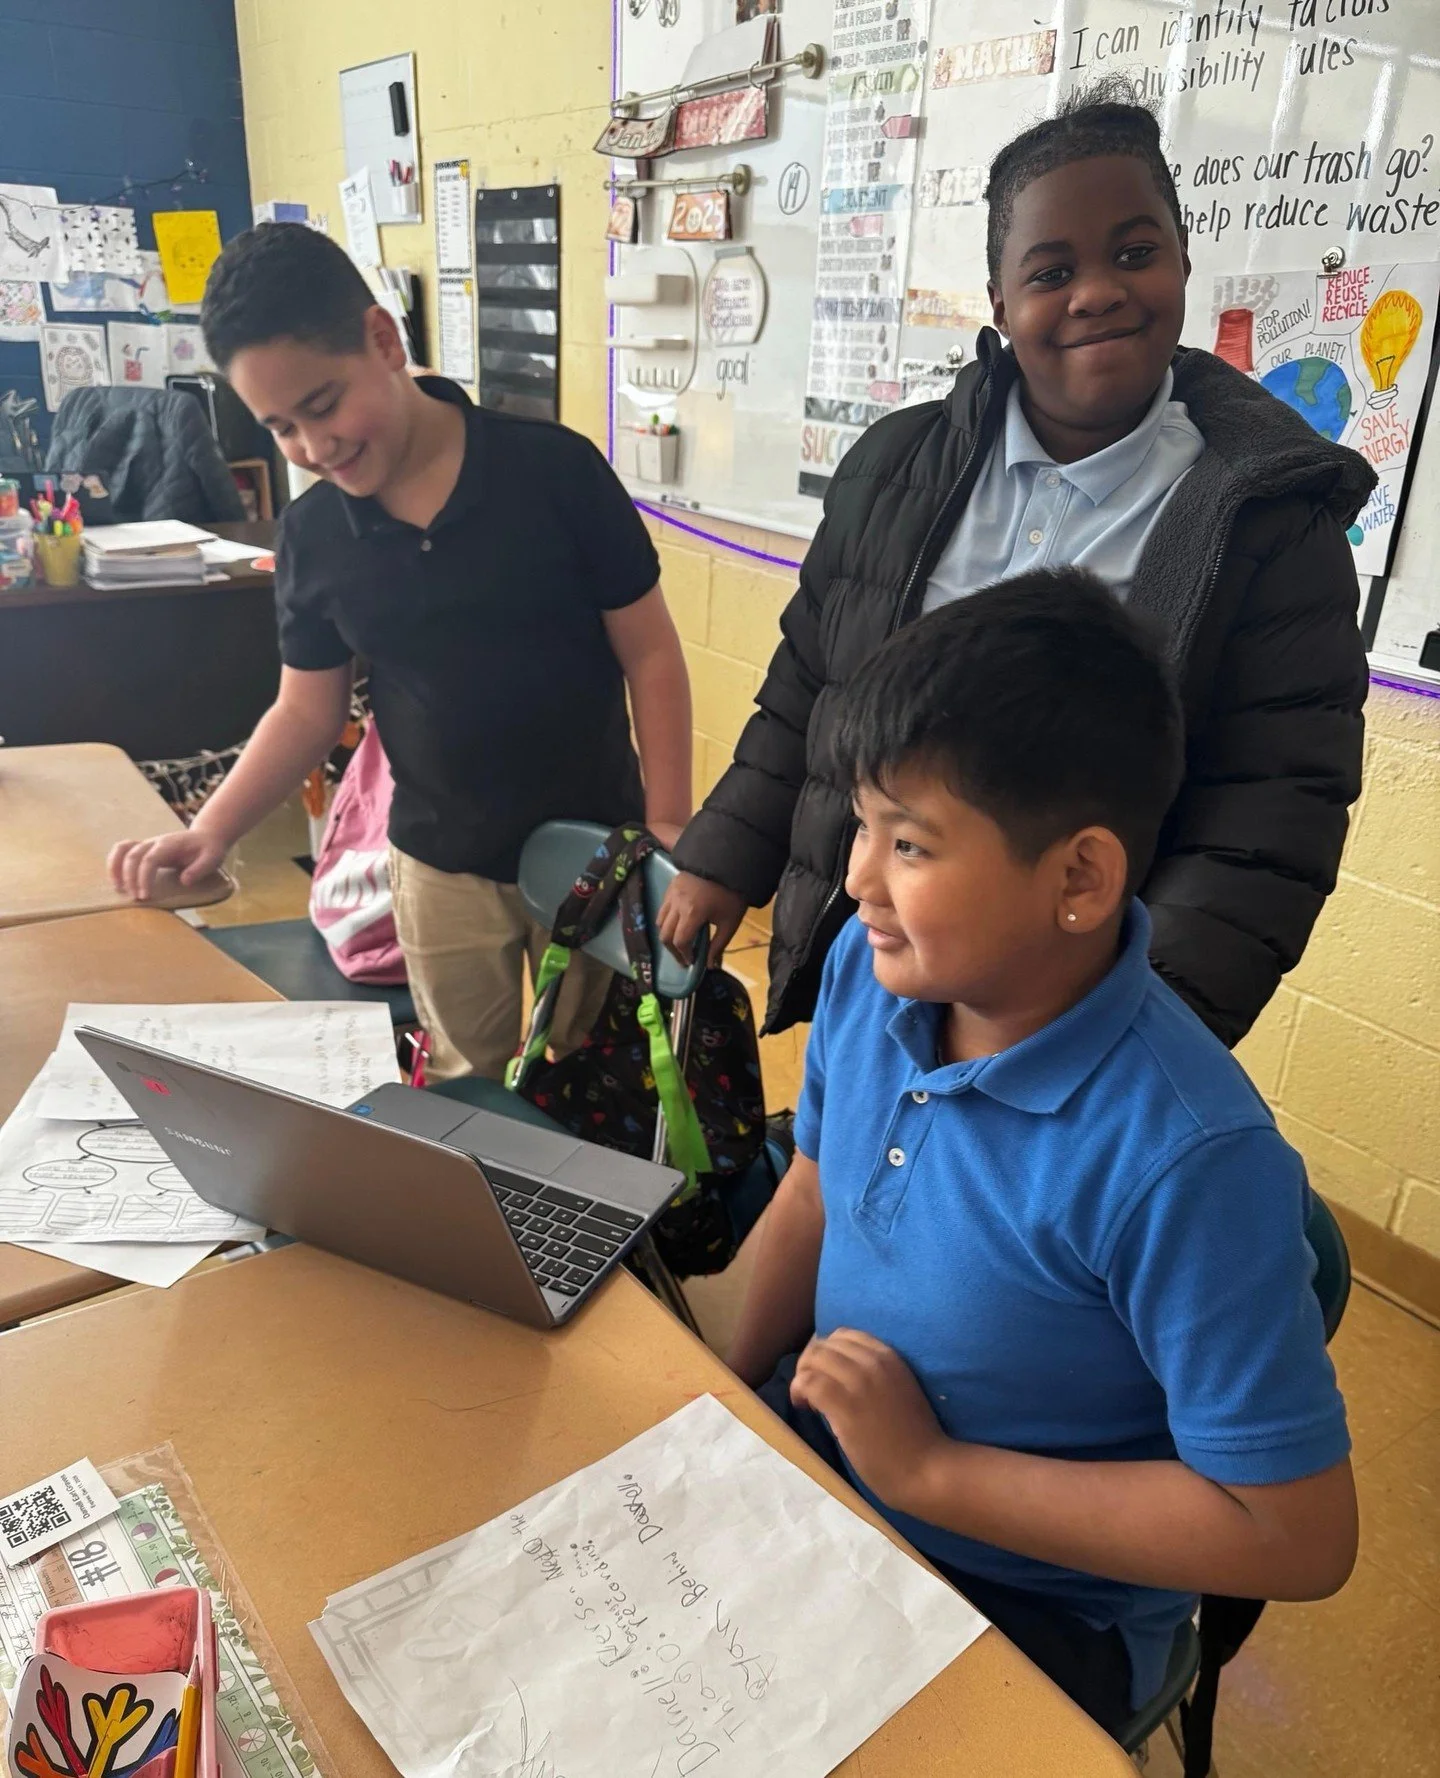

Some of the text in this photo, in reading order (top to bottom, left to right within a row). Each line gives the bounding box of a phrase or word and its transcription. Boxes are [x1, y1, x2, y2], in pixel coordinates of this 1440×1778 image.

[1069, 27, 1090, 70] I
[1096, 25, 1139, 60] can
[1160, 4, 1263, 49] identify
[953, 34, 1037, 81] MATH
[1133, 48, 1265, 99] divisibility
[1193, 155, 1244, 187] does
[1254, 149, 1300, 182] our
[1303, 140, 1371, 184] trash
[1385, 133, 1434, 197] go?
[672, 198, 726, 234] 2025
[1184, 193, 1440, 242] help reduce waste
[1325, 283, 1368, 306] REUSE.
[1327, 266, 1374, 290] REDUCE.
[1256, 308, 1280, 334] STOP
[1257, 298, 1312, 348] POLLUTION!
[1271, 341, 1347, 369] OUR PLANET!
[1361, 403, 1399, 440] SAVE
[1366, 485, 1390, 508] AVE
[1361, 503, 1396, 532] WATER
[662, 1551, 709, 1607] Behind
